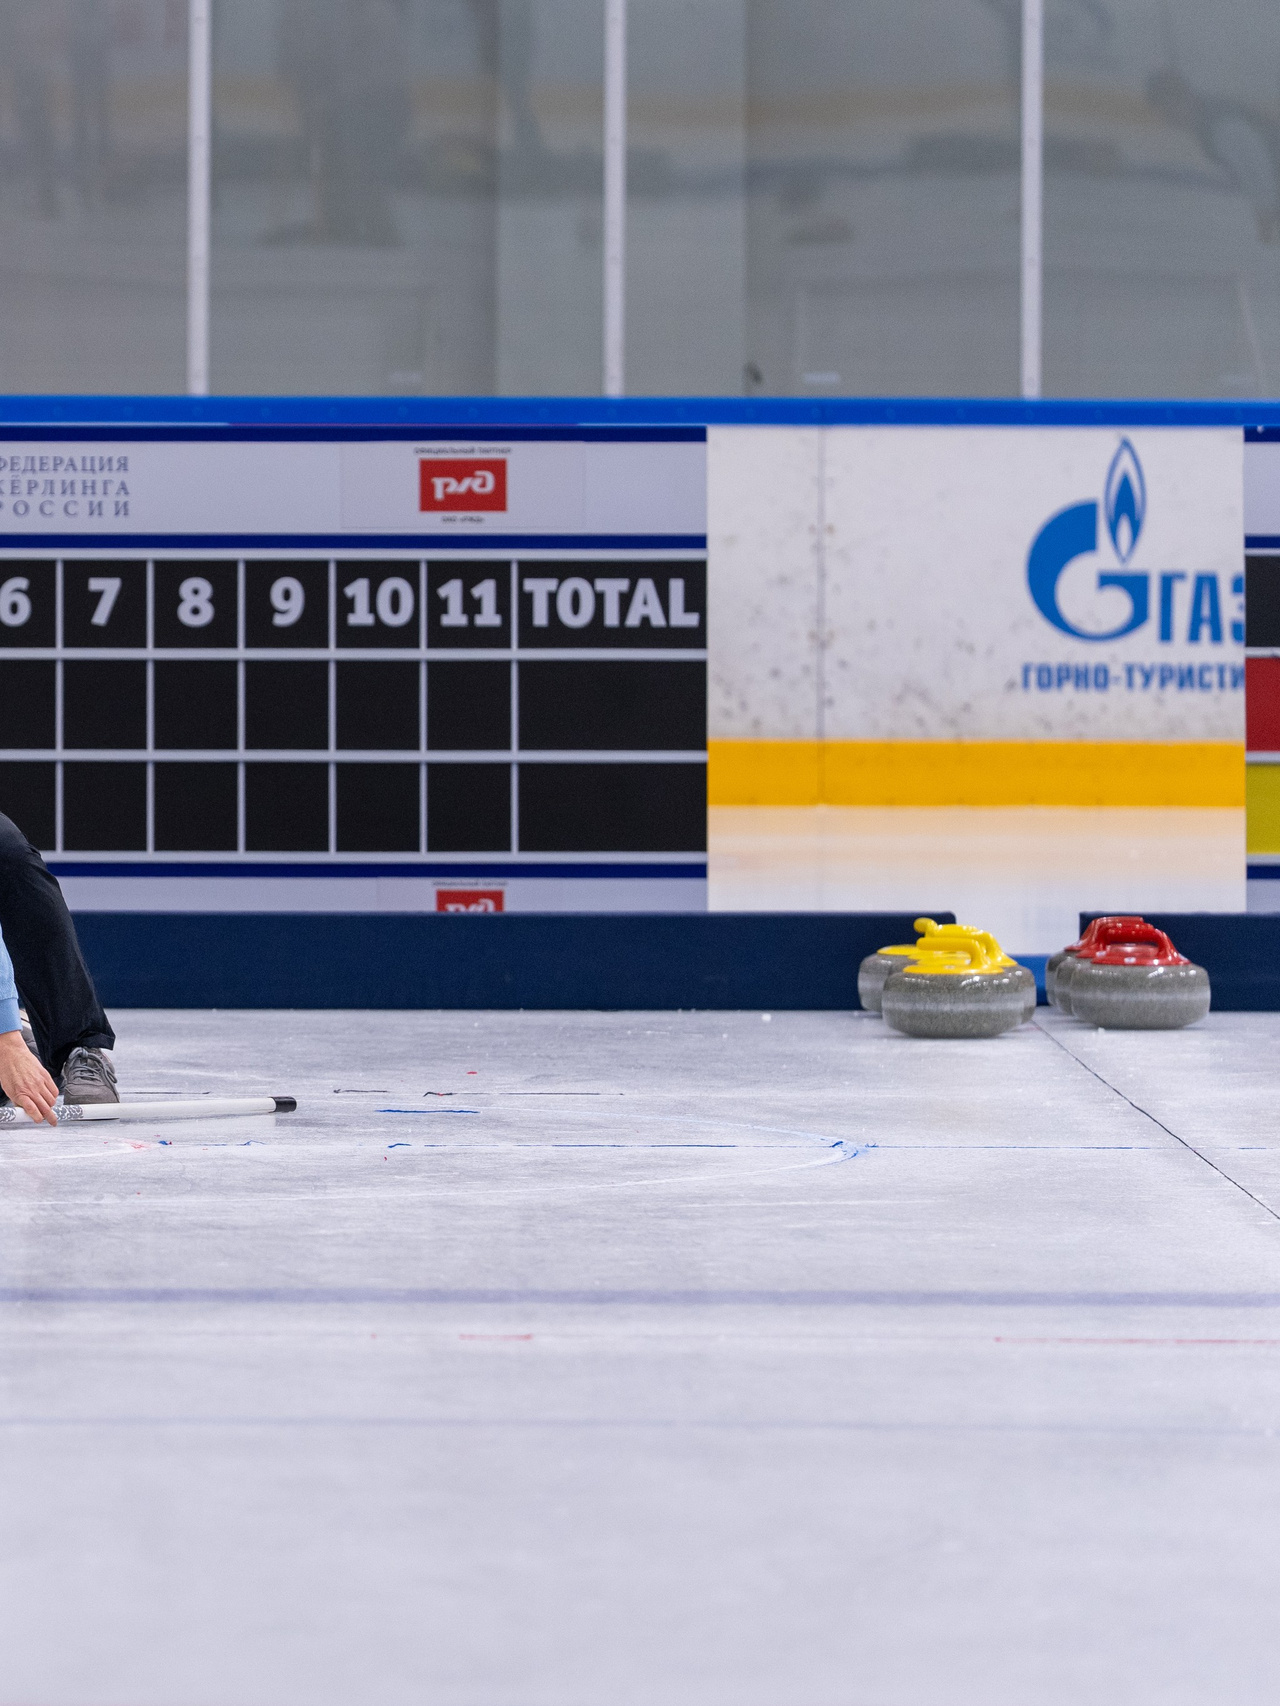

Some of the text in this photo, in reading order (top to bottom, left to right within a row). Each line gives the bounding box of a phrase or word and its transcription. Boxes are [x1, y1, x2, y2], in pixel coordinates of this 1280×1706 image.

[88, 577, 121, 626] 7
[177, 577, 214, 627] 8
[270, 576, 304, 626] 9
[344, 577, 414, 627] 10
[437, 578, 502, 627] 11
[523, 577, 700, 628] TOTAL
